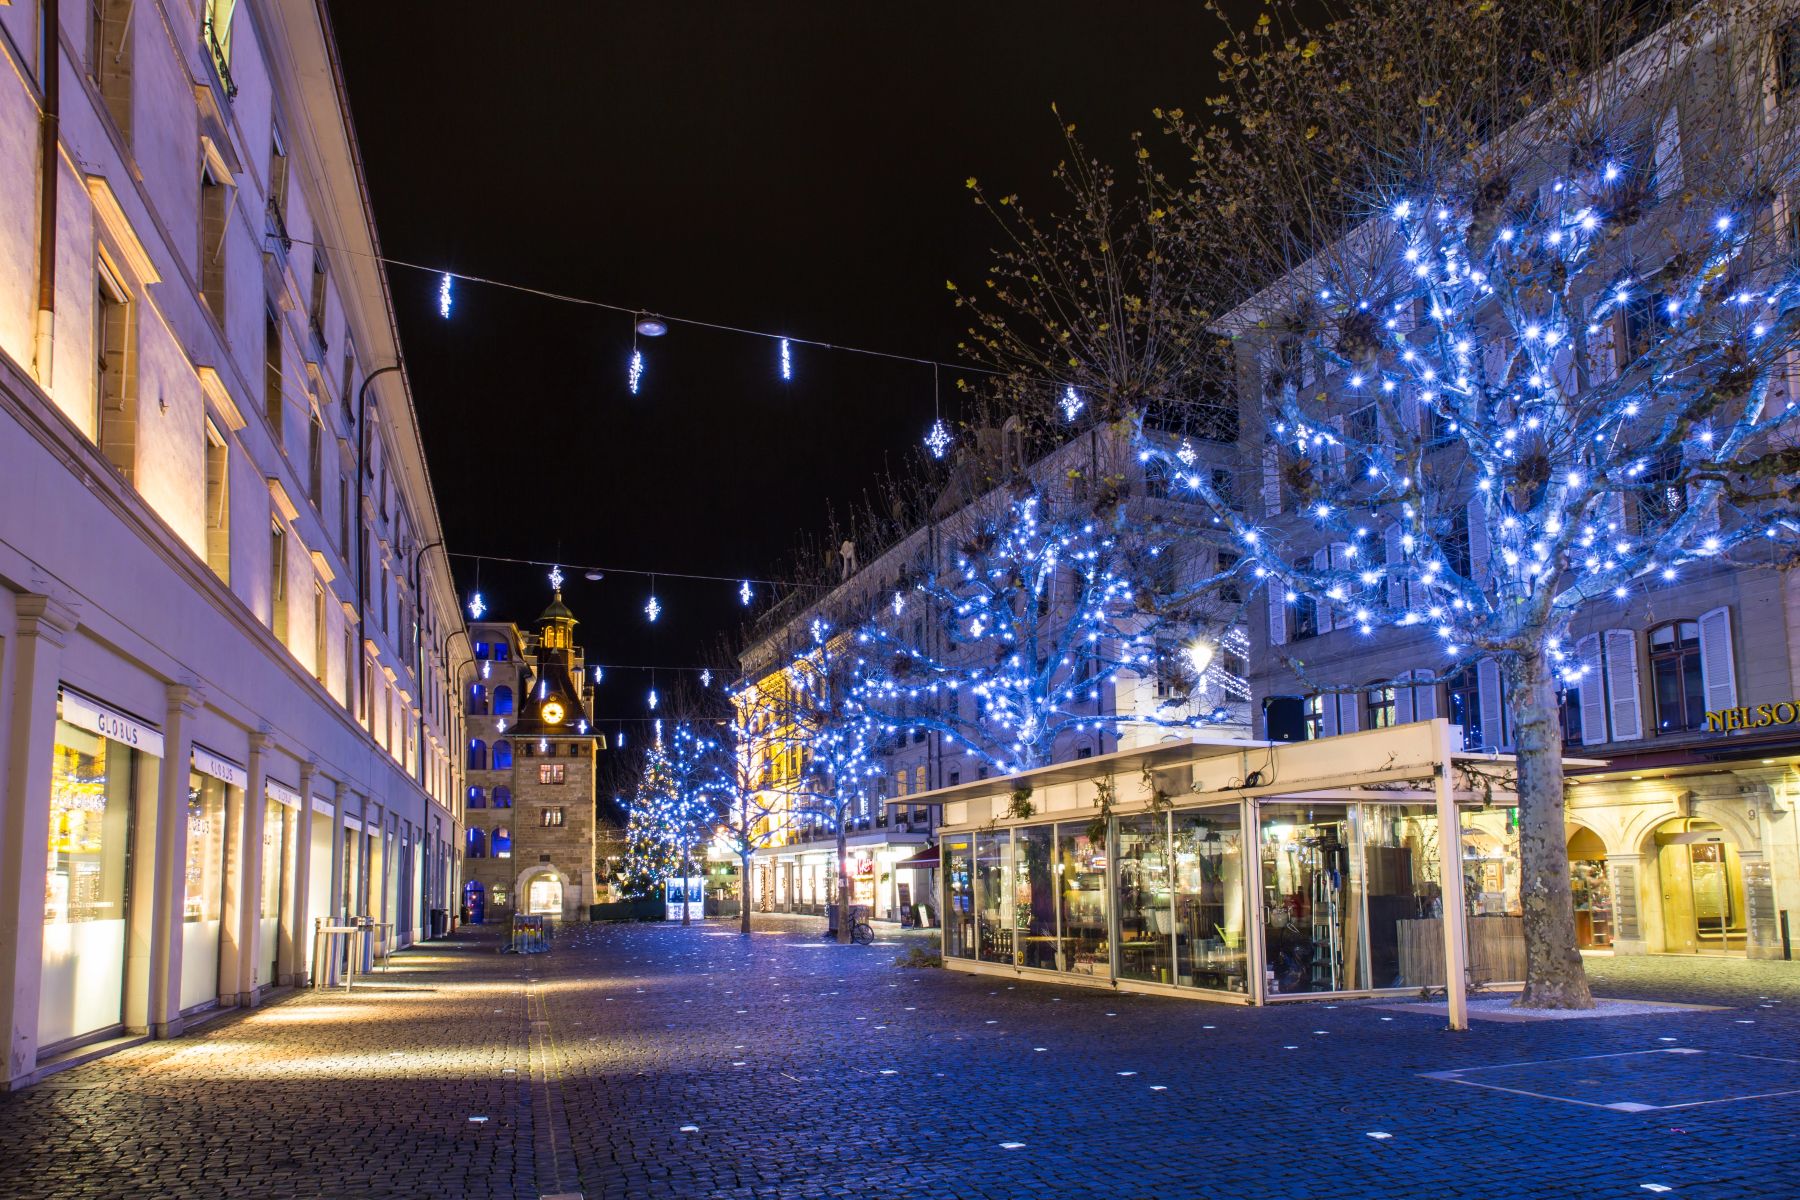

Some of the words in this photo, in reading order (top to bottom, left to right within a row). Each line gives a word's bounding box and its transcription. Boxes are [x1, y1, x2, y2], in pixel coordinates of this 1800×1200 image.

[1705, 700, 1800, 732] NELSO
[98, 713, 138, 745] GLOBUS
[1748, 809, 1756, 821] 9
[1748, 886, 1755, 895] 5
[1749, 897, 1756, 905] 4
[1750, 907, 1757, 916] 3
[1751, 918, 1758, 927] 2
[1753, 928, 1759, 937] 1
